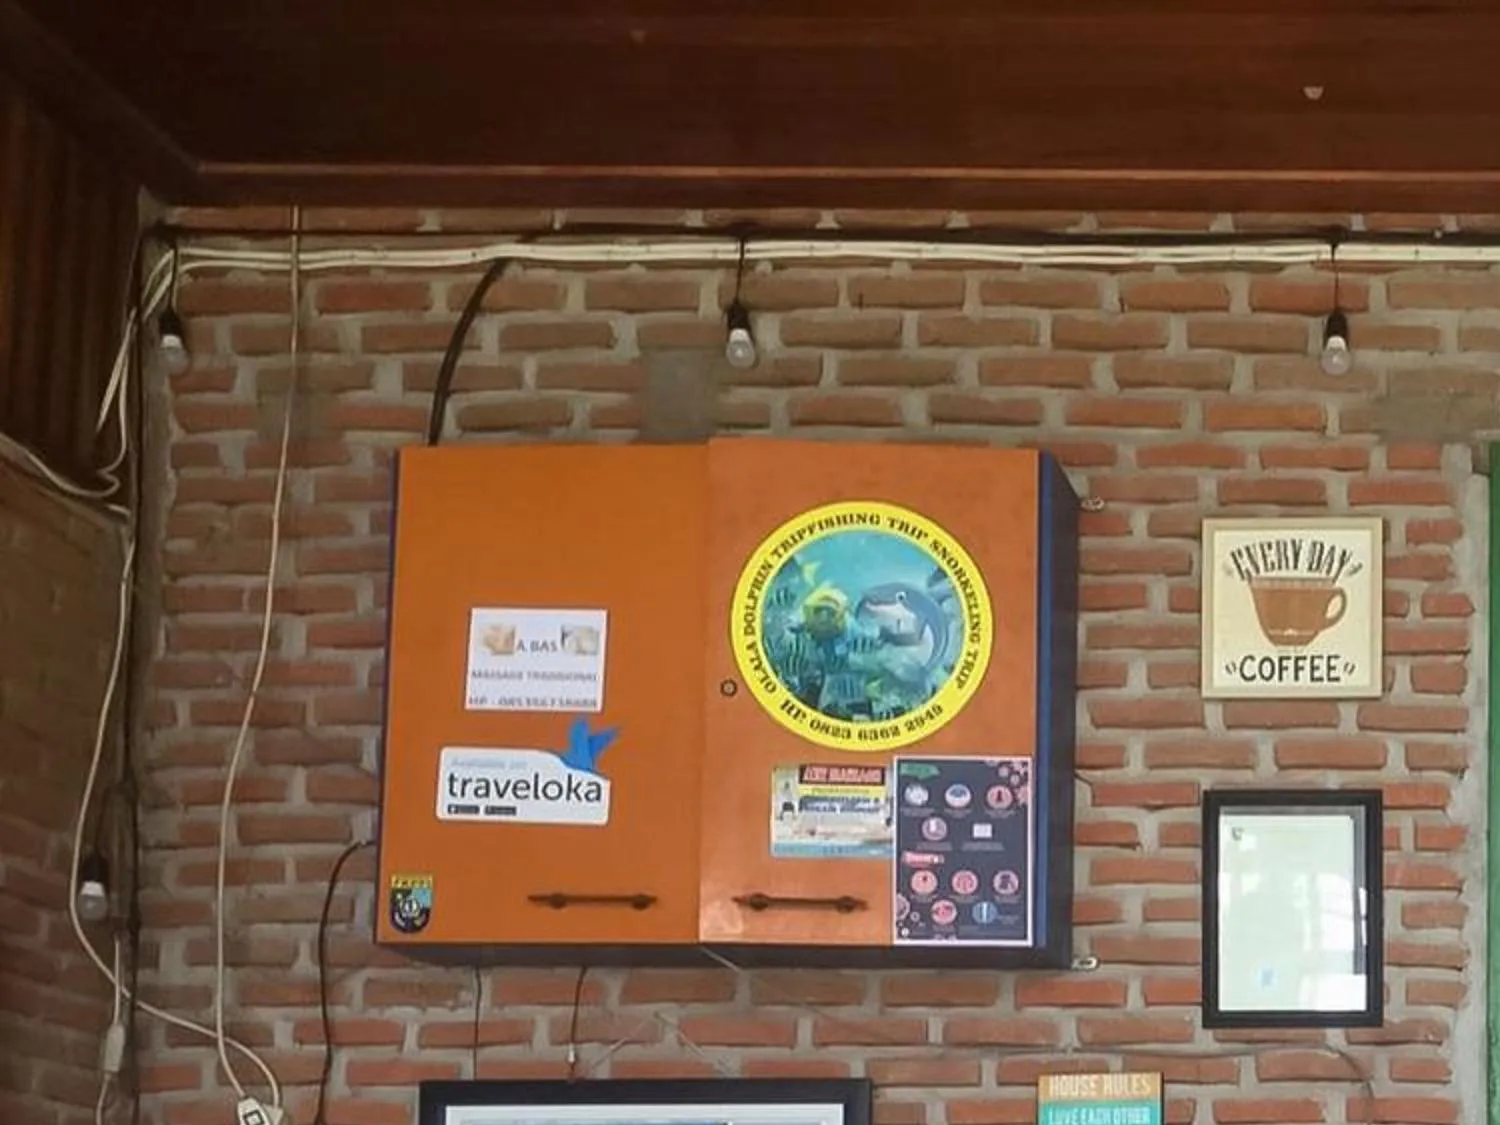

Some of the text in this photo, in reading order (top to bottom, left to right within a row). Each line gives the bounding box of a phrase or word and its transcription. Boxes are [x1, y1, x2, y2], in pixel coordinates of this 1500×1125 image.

[1230, 538, 1353, 584] EVERY DAY
[742, 558, 773, 637] DOLPHIN
[1239, 654, 1341, 683] COFFEE
[448, 772, 603, 803] traveloka
[1049, 1073, 1151, 1097] HOUSE RULES
